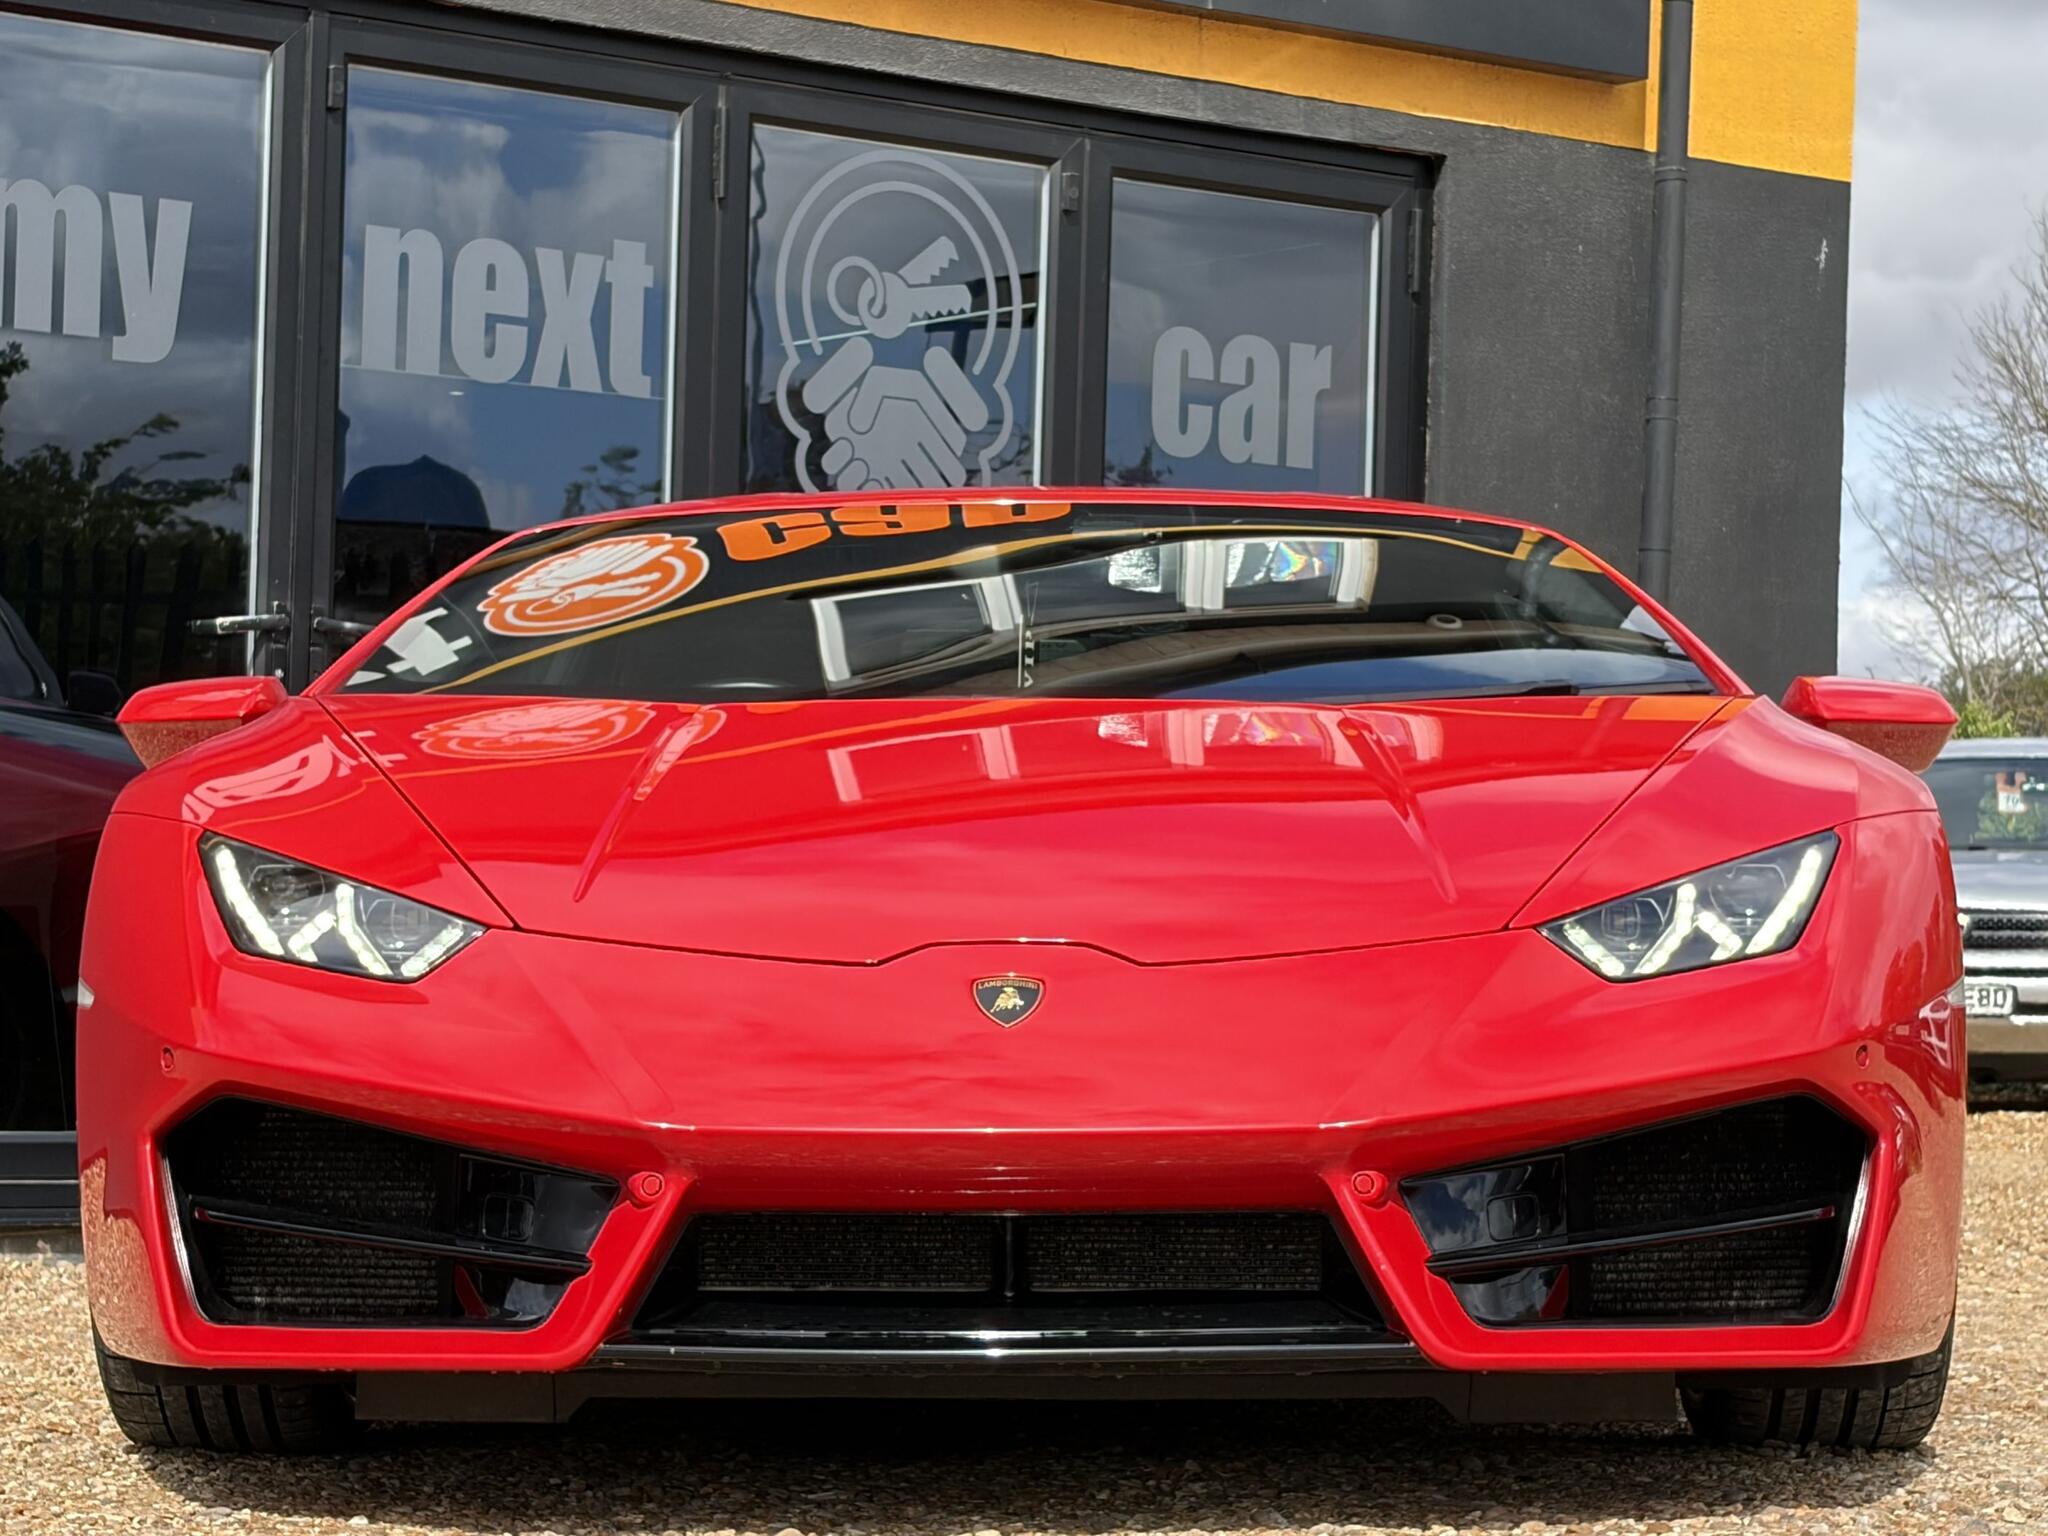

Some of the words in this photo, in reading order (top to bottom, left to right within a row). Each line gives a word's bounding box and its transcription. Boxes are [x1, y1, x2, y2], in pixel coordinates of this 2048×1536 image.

[0, 179, 193, 362] my
[363, 225, 654, 398] next
[1151, 326, 1332, 469] car
[977, 979, 1039, 989] LAMBORGHINI
